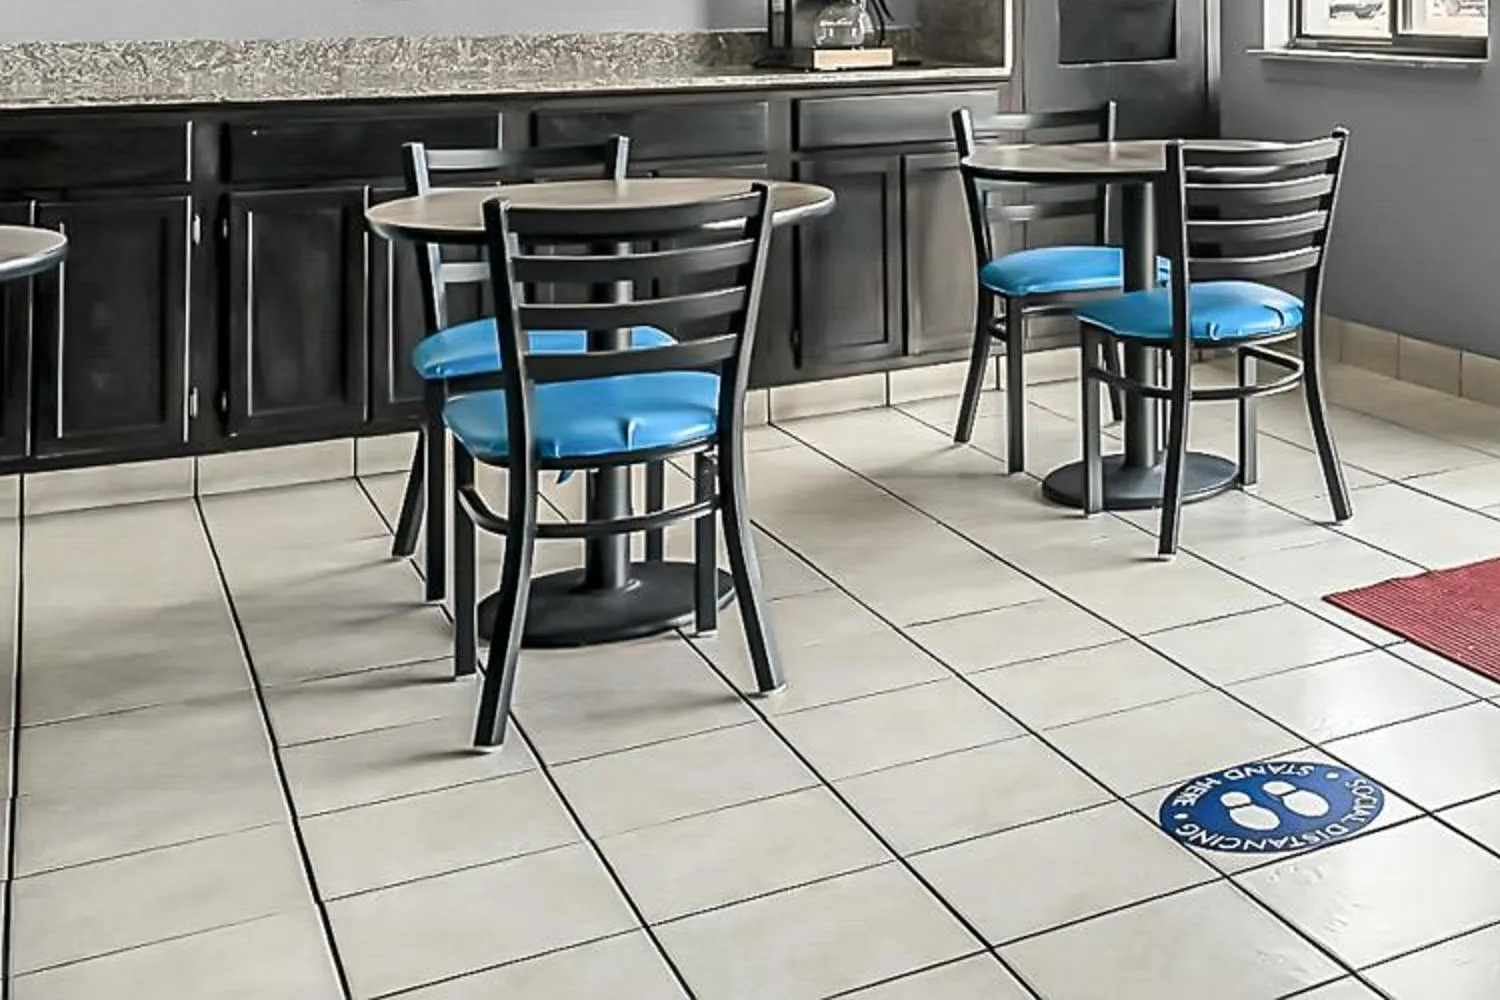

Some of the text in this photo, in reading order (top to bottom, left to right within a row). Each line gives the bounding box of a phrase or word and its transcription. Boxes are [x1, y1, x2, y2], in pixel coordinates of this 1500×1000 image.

[1171, 763, 1316, 808] STAND HERE
[1175, 778, 1378, 851] SOCIAL DISTANCING
